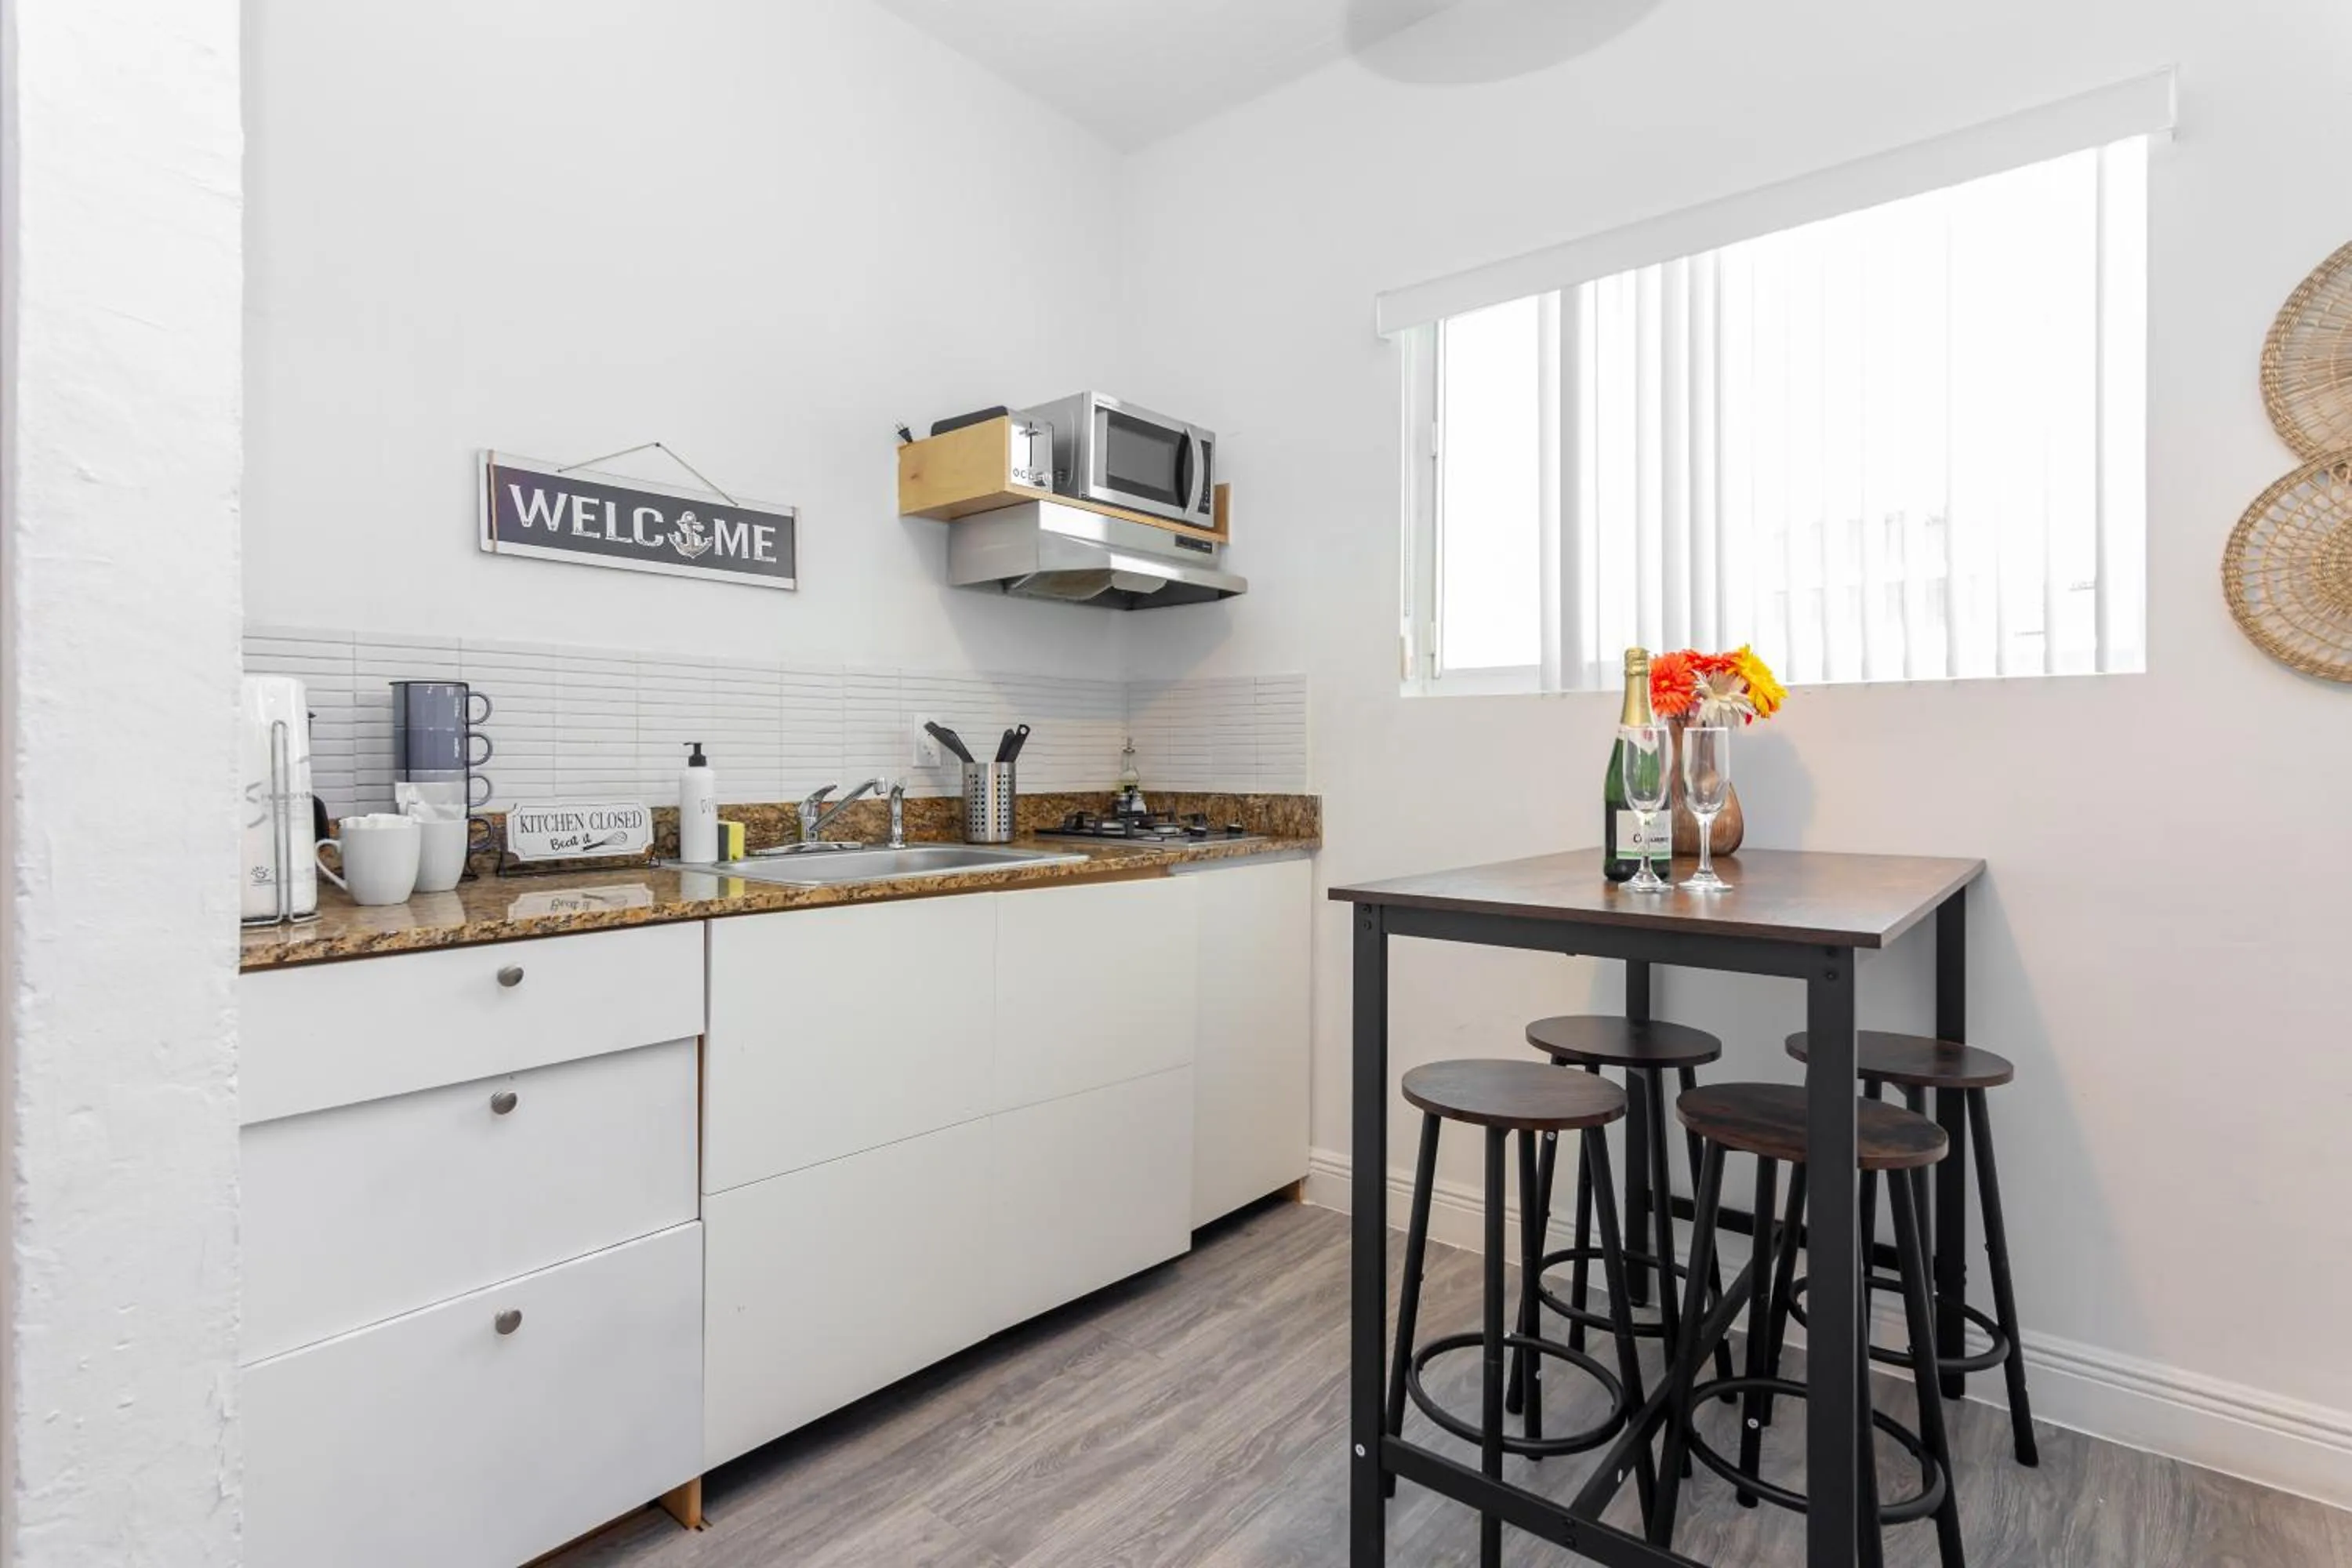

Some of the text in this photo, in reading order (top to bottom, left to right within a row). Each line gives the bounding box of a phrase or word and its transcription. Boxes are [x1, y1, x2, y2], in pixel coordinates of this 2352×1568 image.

[509, 484, 776, 563] WELCME
[520, 810, 642, 833] KITCHEN CLOSED
[550, 833, 591, 851] Beat it
